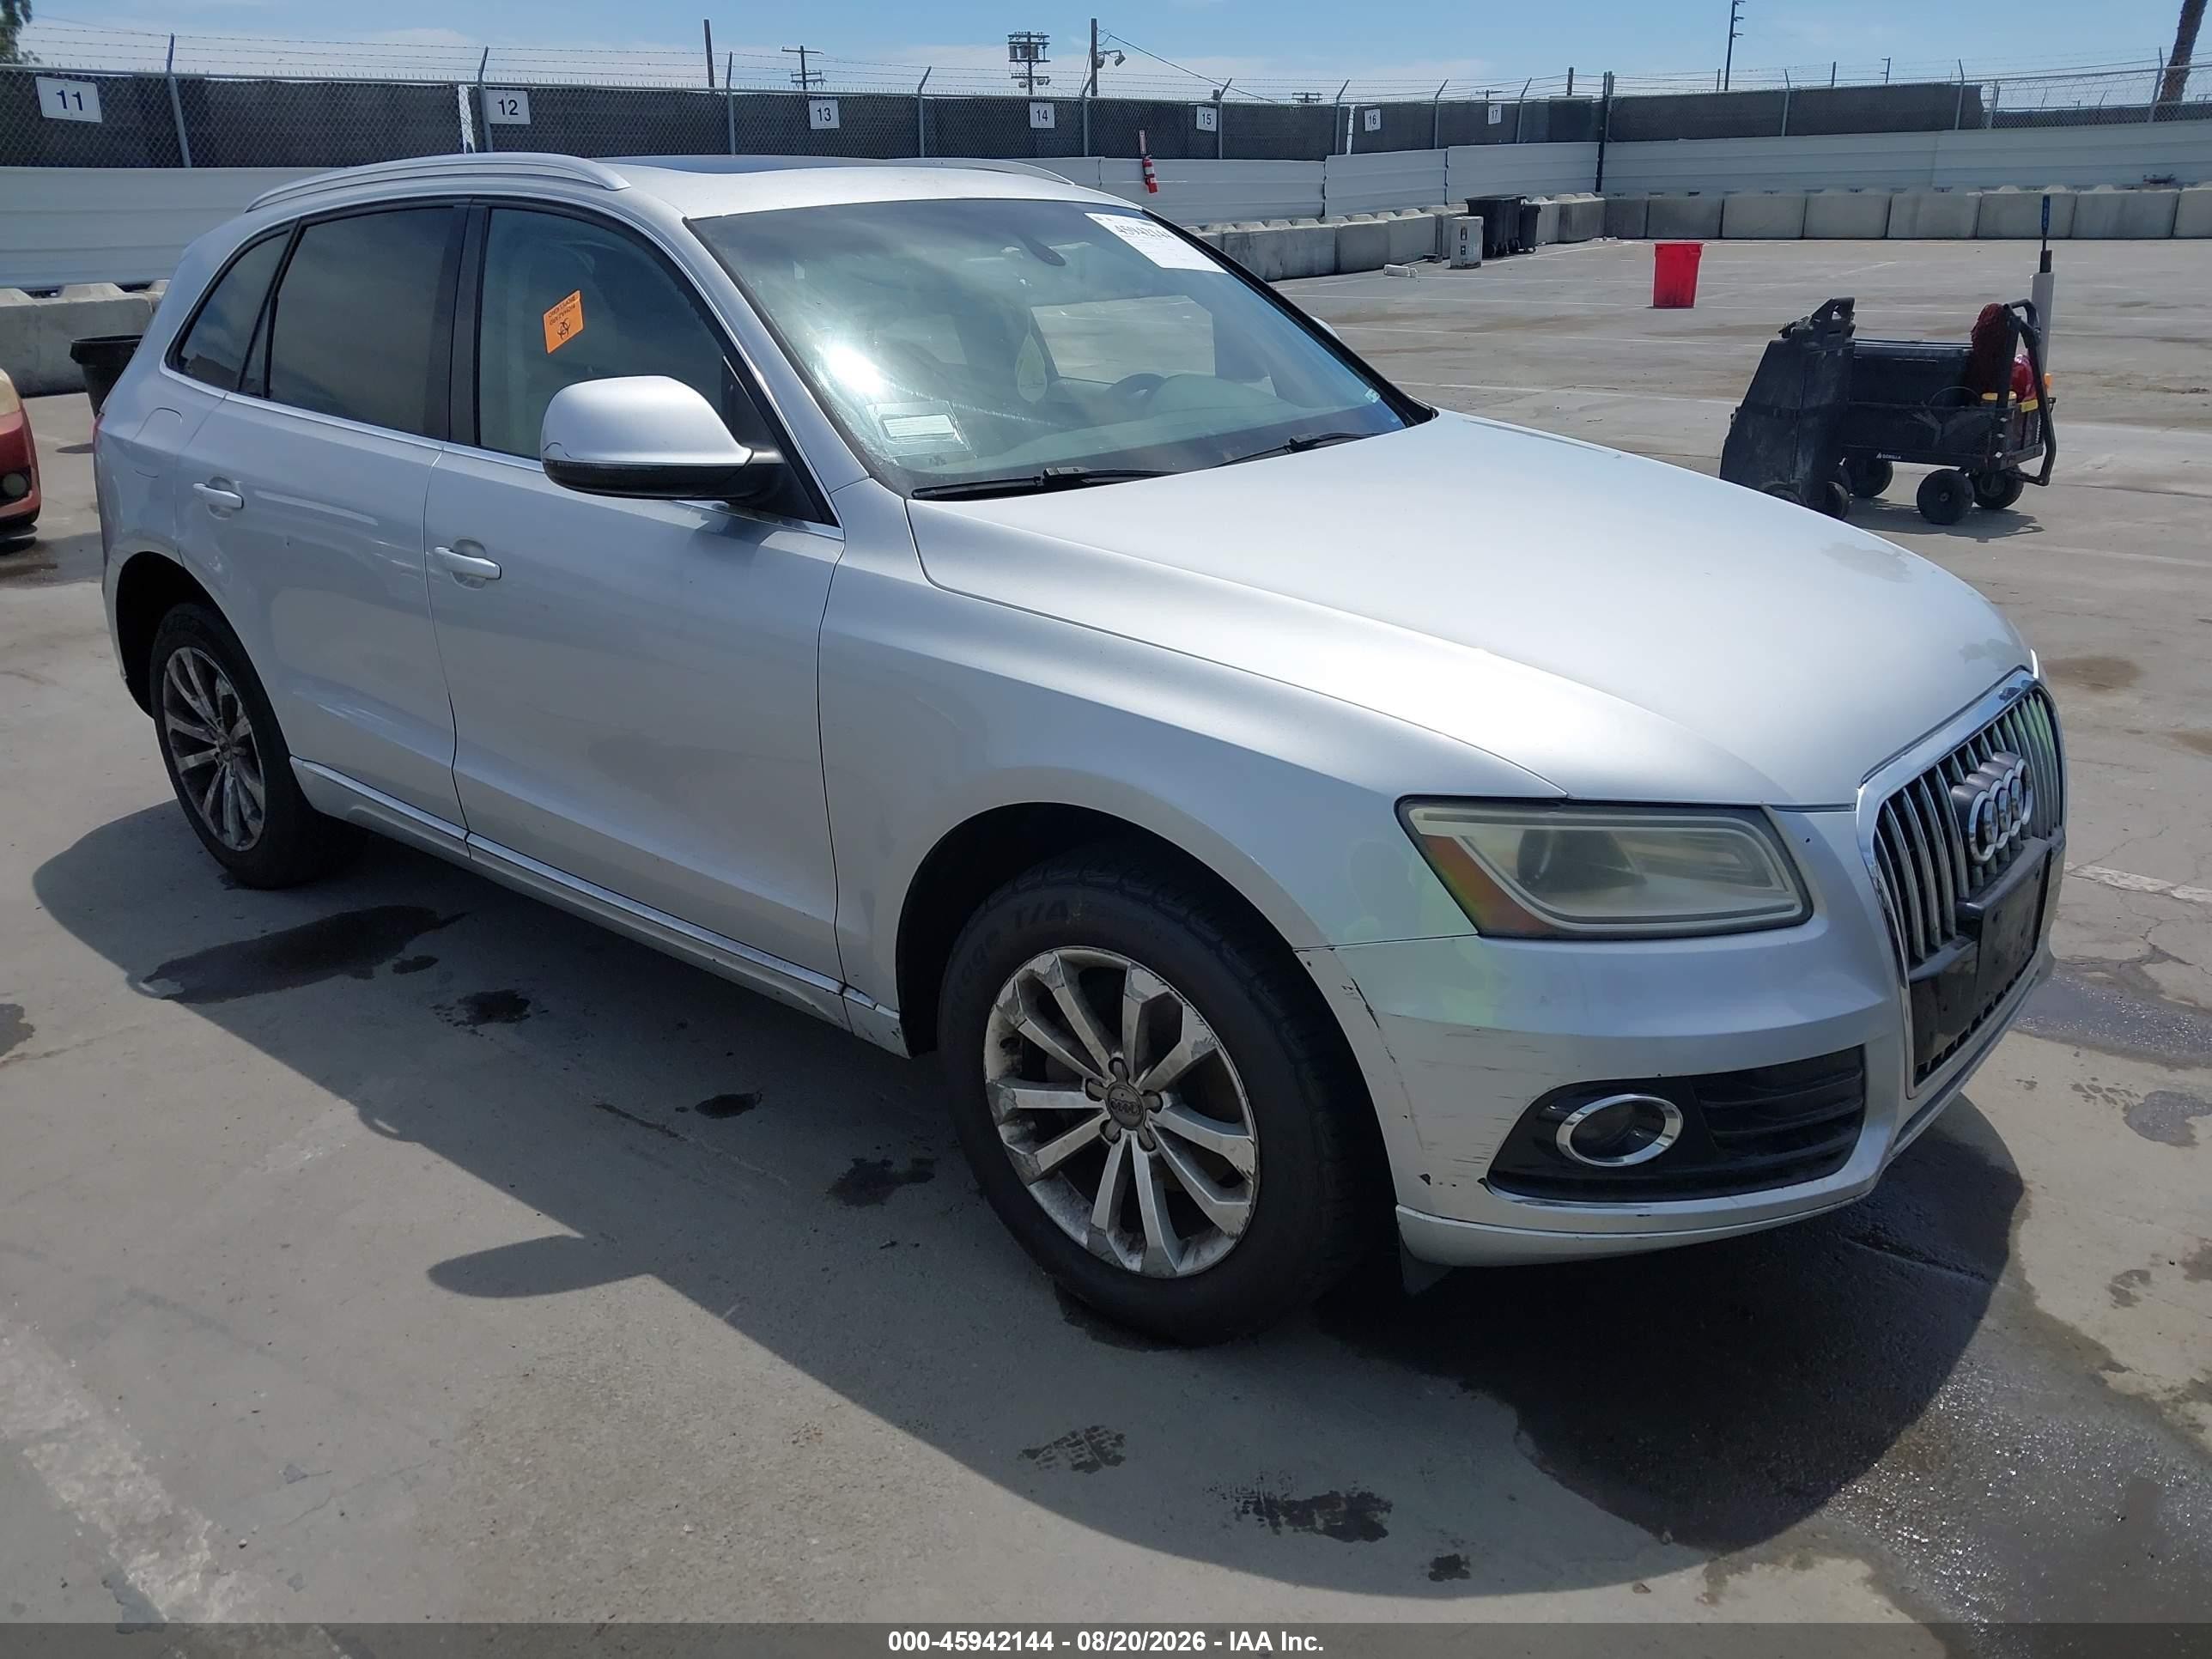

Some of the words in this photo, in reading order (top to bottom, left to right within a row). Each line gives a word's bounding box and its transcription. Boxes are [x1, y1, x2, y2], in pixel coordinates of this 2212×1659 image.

[57, 89, 83, 112] 11
[498, 98, 520, 117] 12
[817, 106, 832, 122] 13
[1036, 109, 1048, 122] 14
[1201, 112, 1212, 126] 15
[1369, 113, 1377, 126] 16
[1491, 109, 1498, 120] 17
